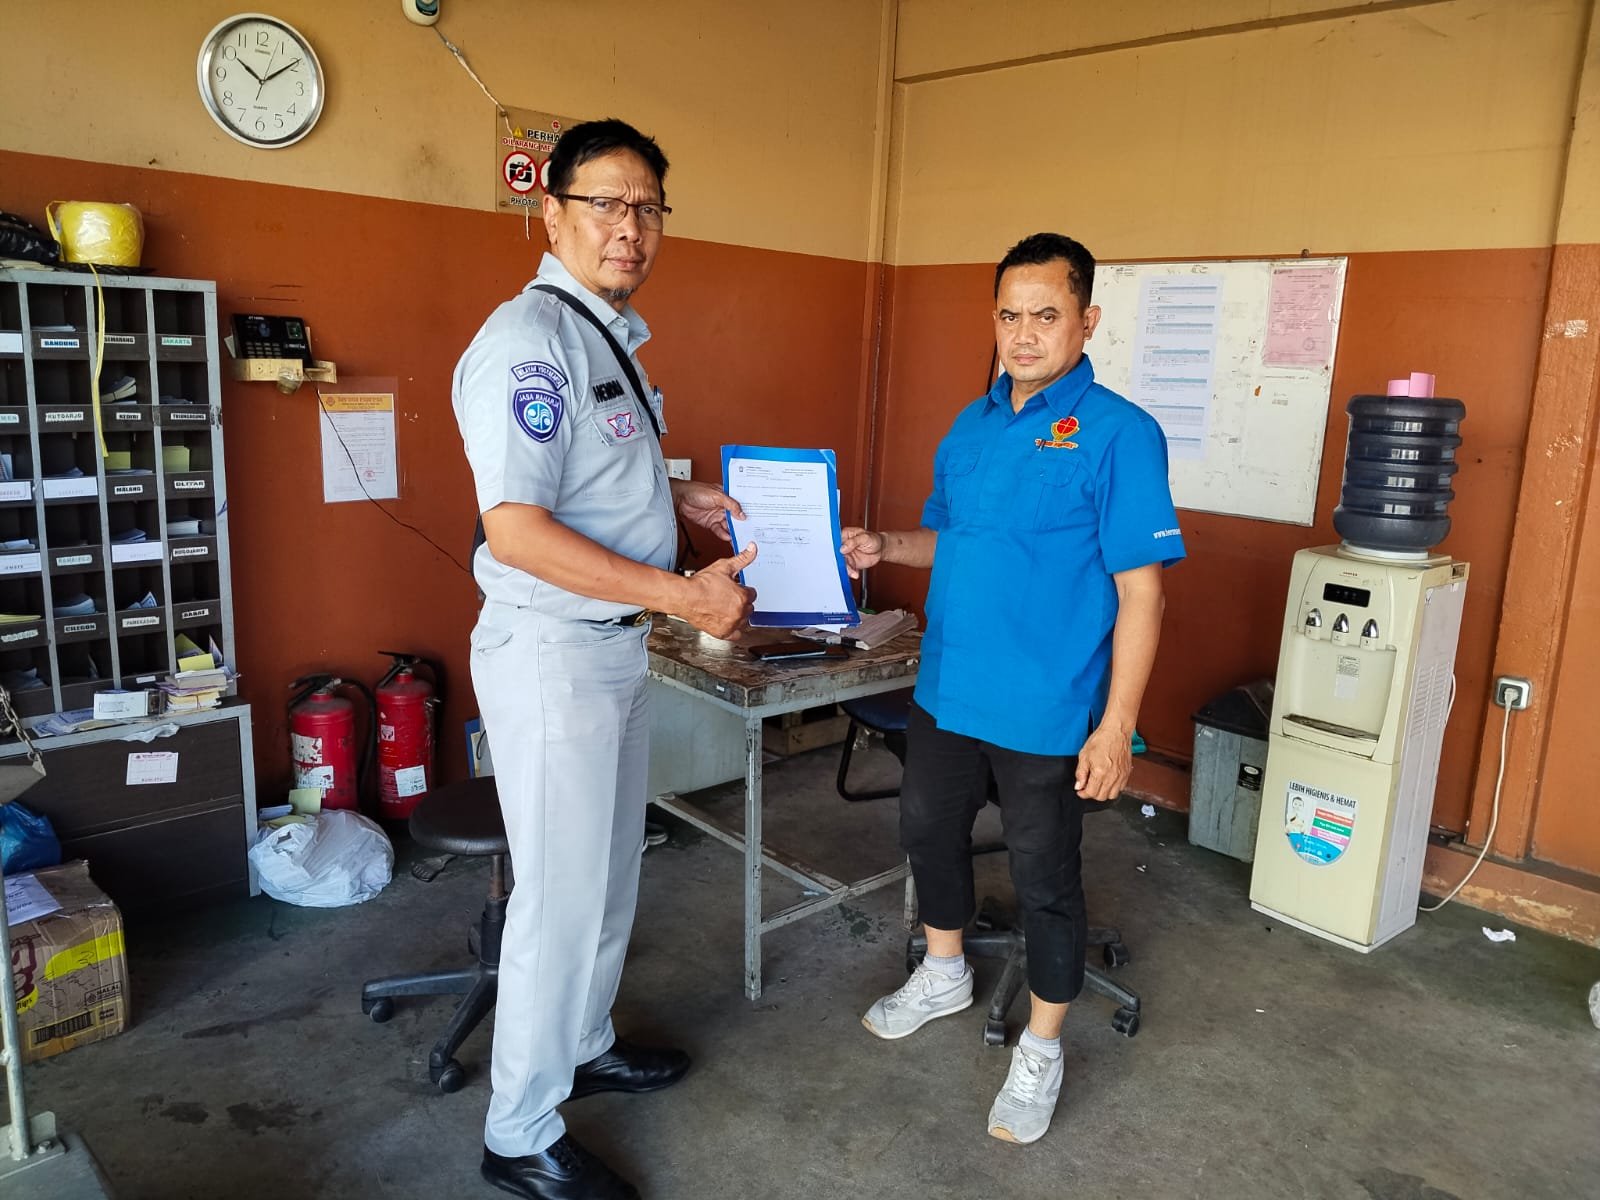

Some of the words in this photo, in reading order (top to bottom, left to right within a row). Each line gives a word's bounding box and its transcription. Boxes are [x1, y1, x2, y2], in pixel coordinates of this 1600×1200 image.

[238, 33, 247, 48] 11
[256, 31, 269, 47] 12
[222, 45, 237, 61] 10
[290, 57, 299, 73] 2
[215, 66, 227, 82] 9
[295, 81, 304, 96] 3
[222, 90, 234, 106] 8
[237, 107, 247, 122] 7
[286, 102, 296, 116] 4
[255, 117, 266, 132] 6
[273, 113, 284, 128] 5
[527, 129, 560, 143] PERHA
[502, 138, 539, 150] DILARANG
[510, 196, 538, 207] PHOTO
[163, 337, 191, 345] JAKARTA
[519, 393, 534, 402] JASA
[176, 480, 204, 488] BLITAR
[1289, 781, 1305, 794] LEBIH
[1305, 787, 1330, 801] HIGIENIS
[1336, 796, 1356, 809] HEMAT
